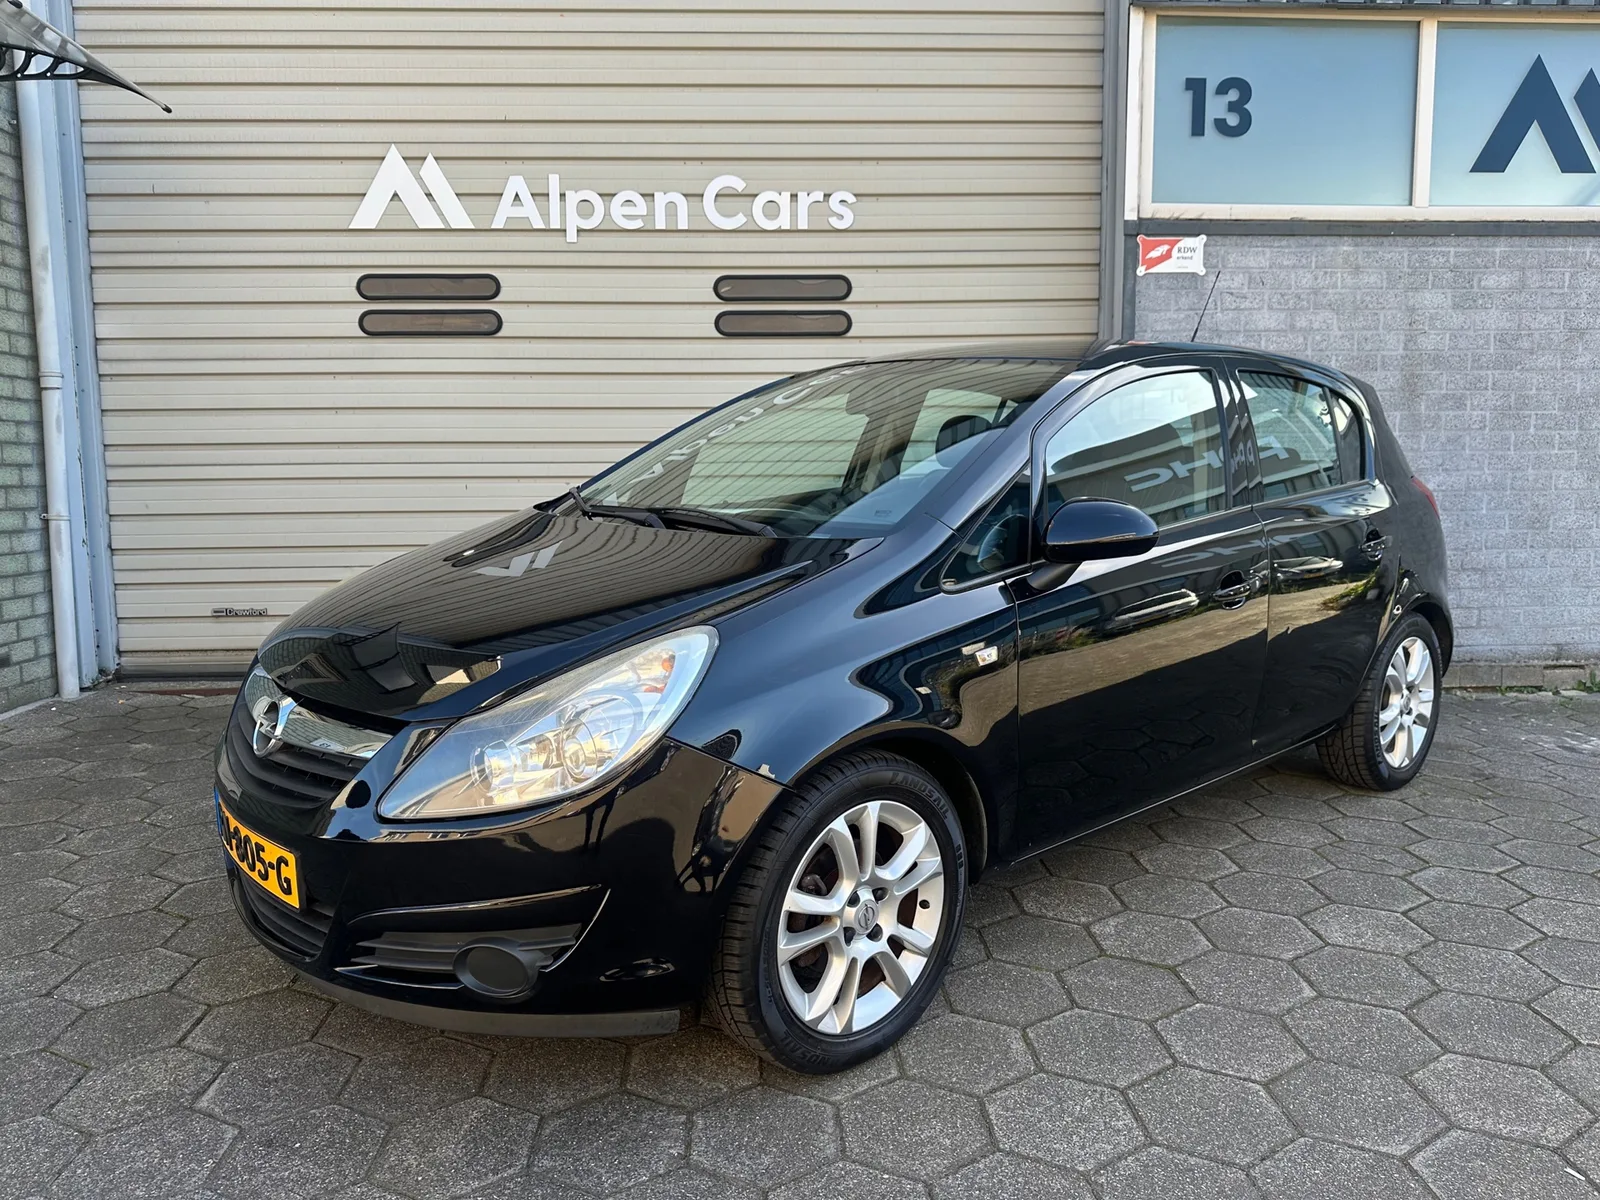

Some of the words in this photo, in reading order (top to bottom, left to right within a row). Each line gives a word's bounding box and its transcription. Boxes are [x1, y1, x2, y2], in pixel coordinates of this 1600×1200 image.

[1185, 76, 1253, 138] 13
[490, 173, 689, 243] Alpen
[702, 174, 858, 231] Cars
[1177, 246, 1198, 254] RDW
[226, 607, 268, 617] Crawford
[890, 771, 950, 821] LANDSAIL
